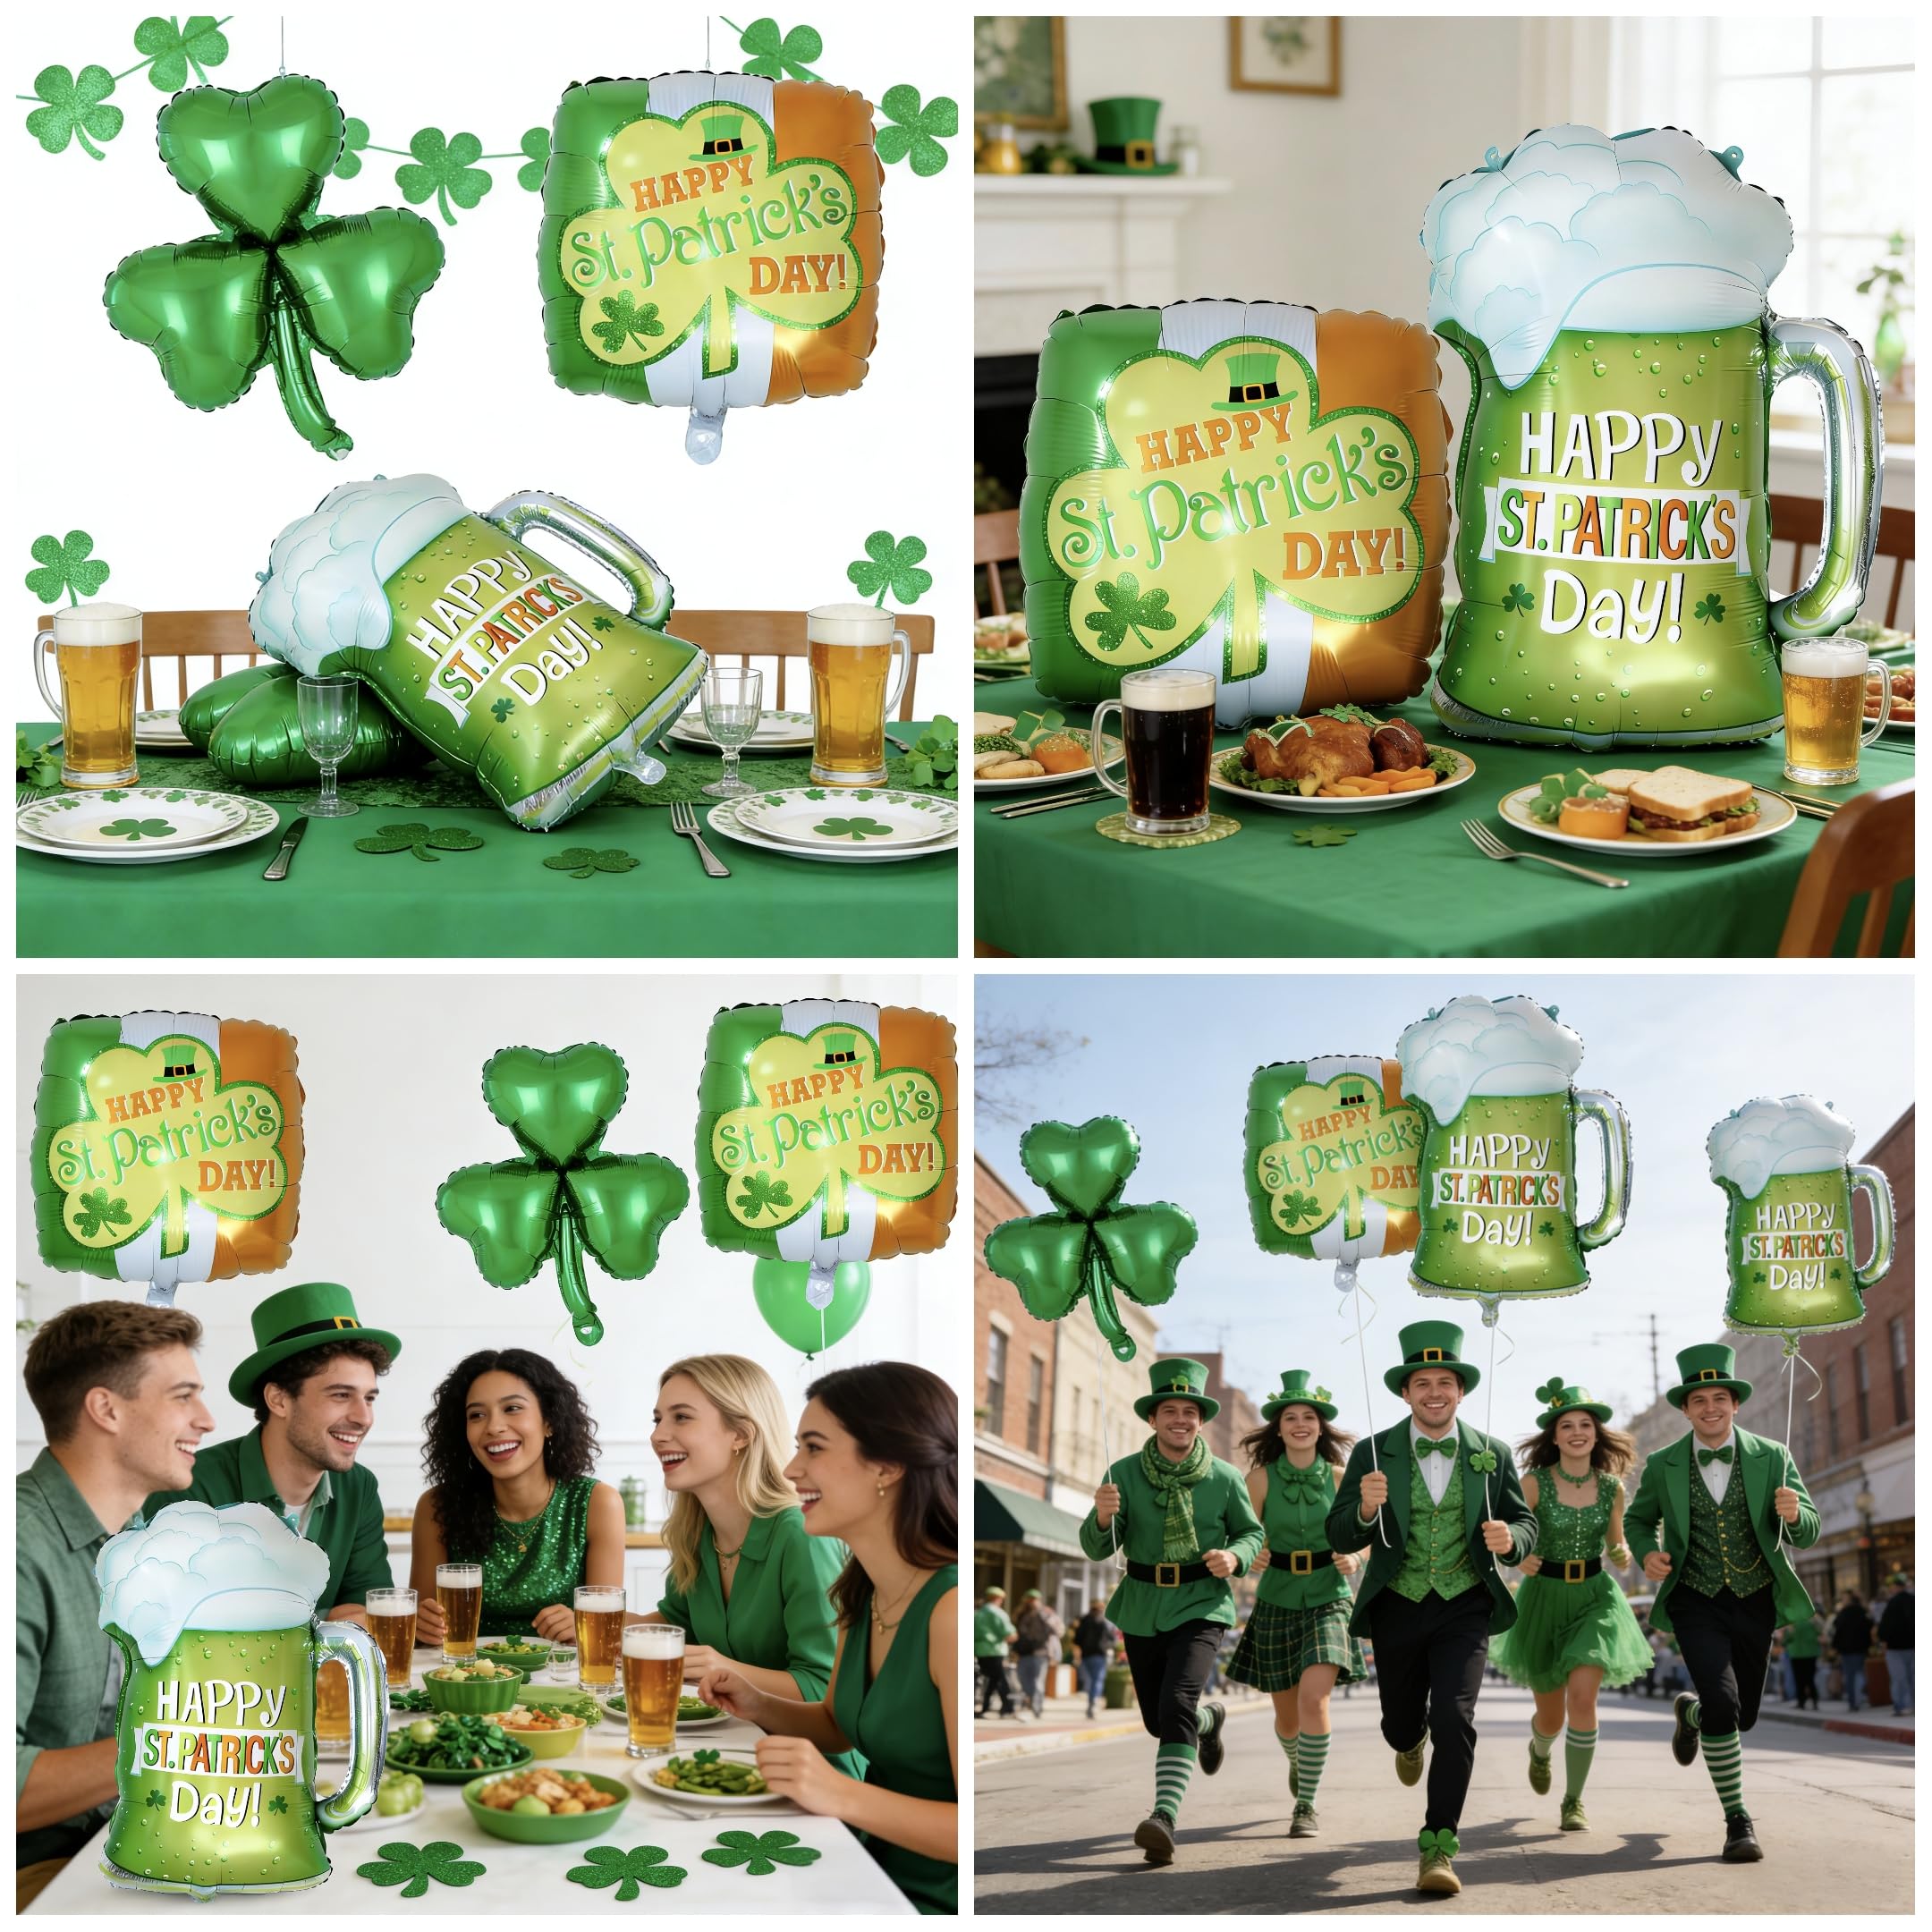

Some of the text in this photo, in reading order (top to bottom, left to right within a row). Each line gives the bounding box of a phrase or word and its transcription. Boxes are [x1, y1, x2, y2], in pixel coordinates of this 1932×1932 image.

[630, 157, 754, 212] HAPPY
[571, 174, 848, 289] St. Patrick's
[749, 254, 847, 295] DAY!
[1135, 402, 1292, 473] HAPPY
[1060, 426, 1409, 570] St. Patrick's
[1282, 527, 1407, 580] DAY!
[1540, 569, 1685, 645] Day!
[500, 617, 603, 706] Day!
[106, 1077, 206, 1124] HAPPY
[767, 1063, 866, 1109] HAPPY
[56, 1094, 277, 1186] St. Patrick's
[719, 1080, 936, 1169] St. Patrick's
[1298, 1106, 1372, 1142] HAPPY
[198, 1159, 275, 1191] DAY!
[858, 1142, 935, 1174] DAY!
[1263, 1116, 1423, 1190] St. Patrick's
[1462, 1211, 1533, 1247] Day!
[1769, 1261, 1826, 1291] Day!
[169, 1781, 262, 1827] Day!
